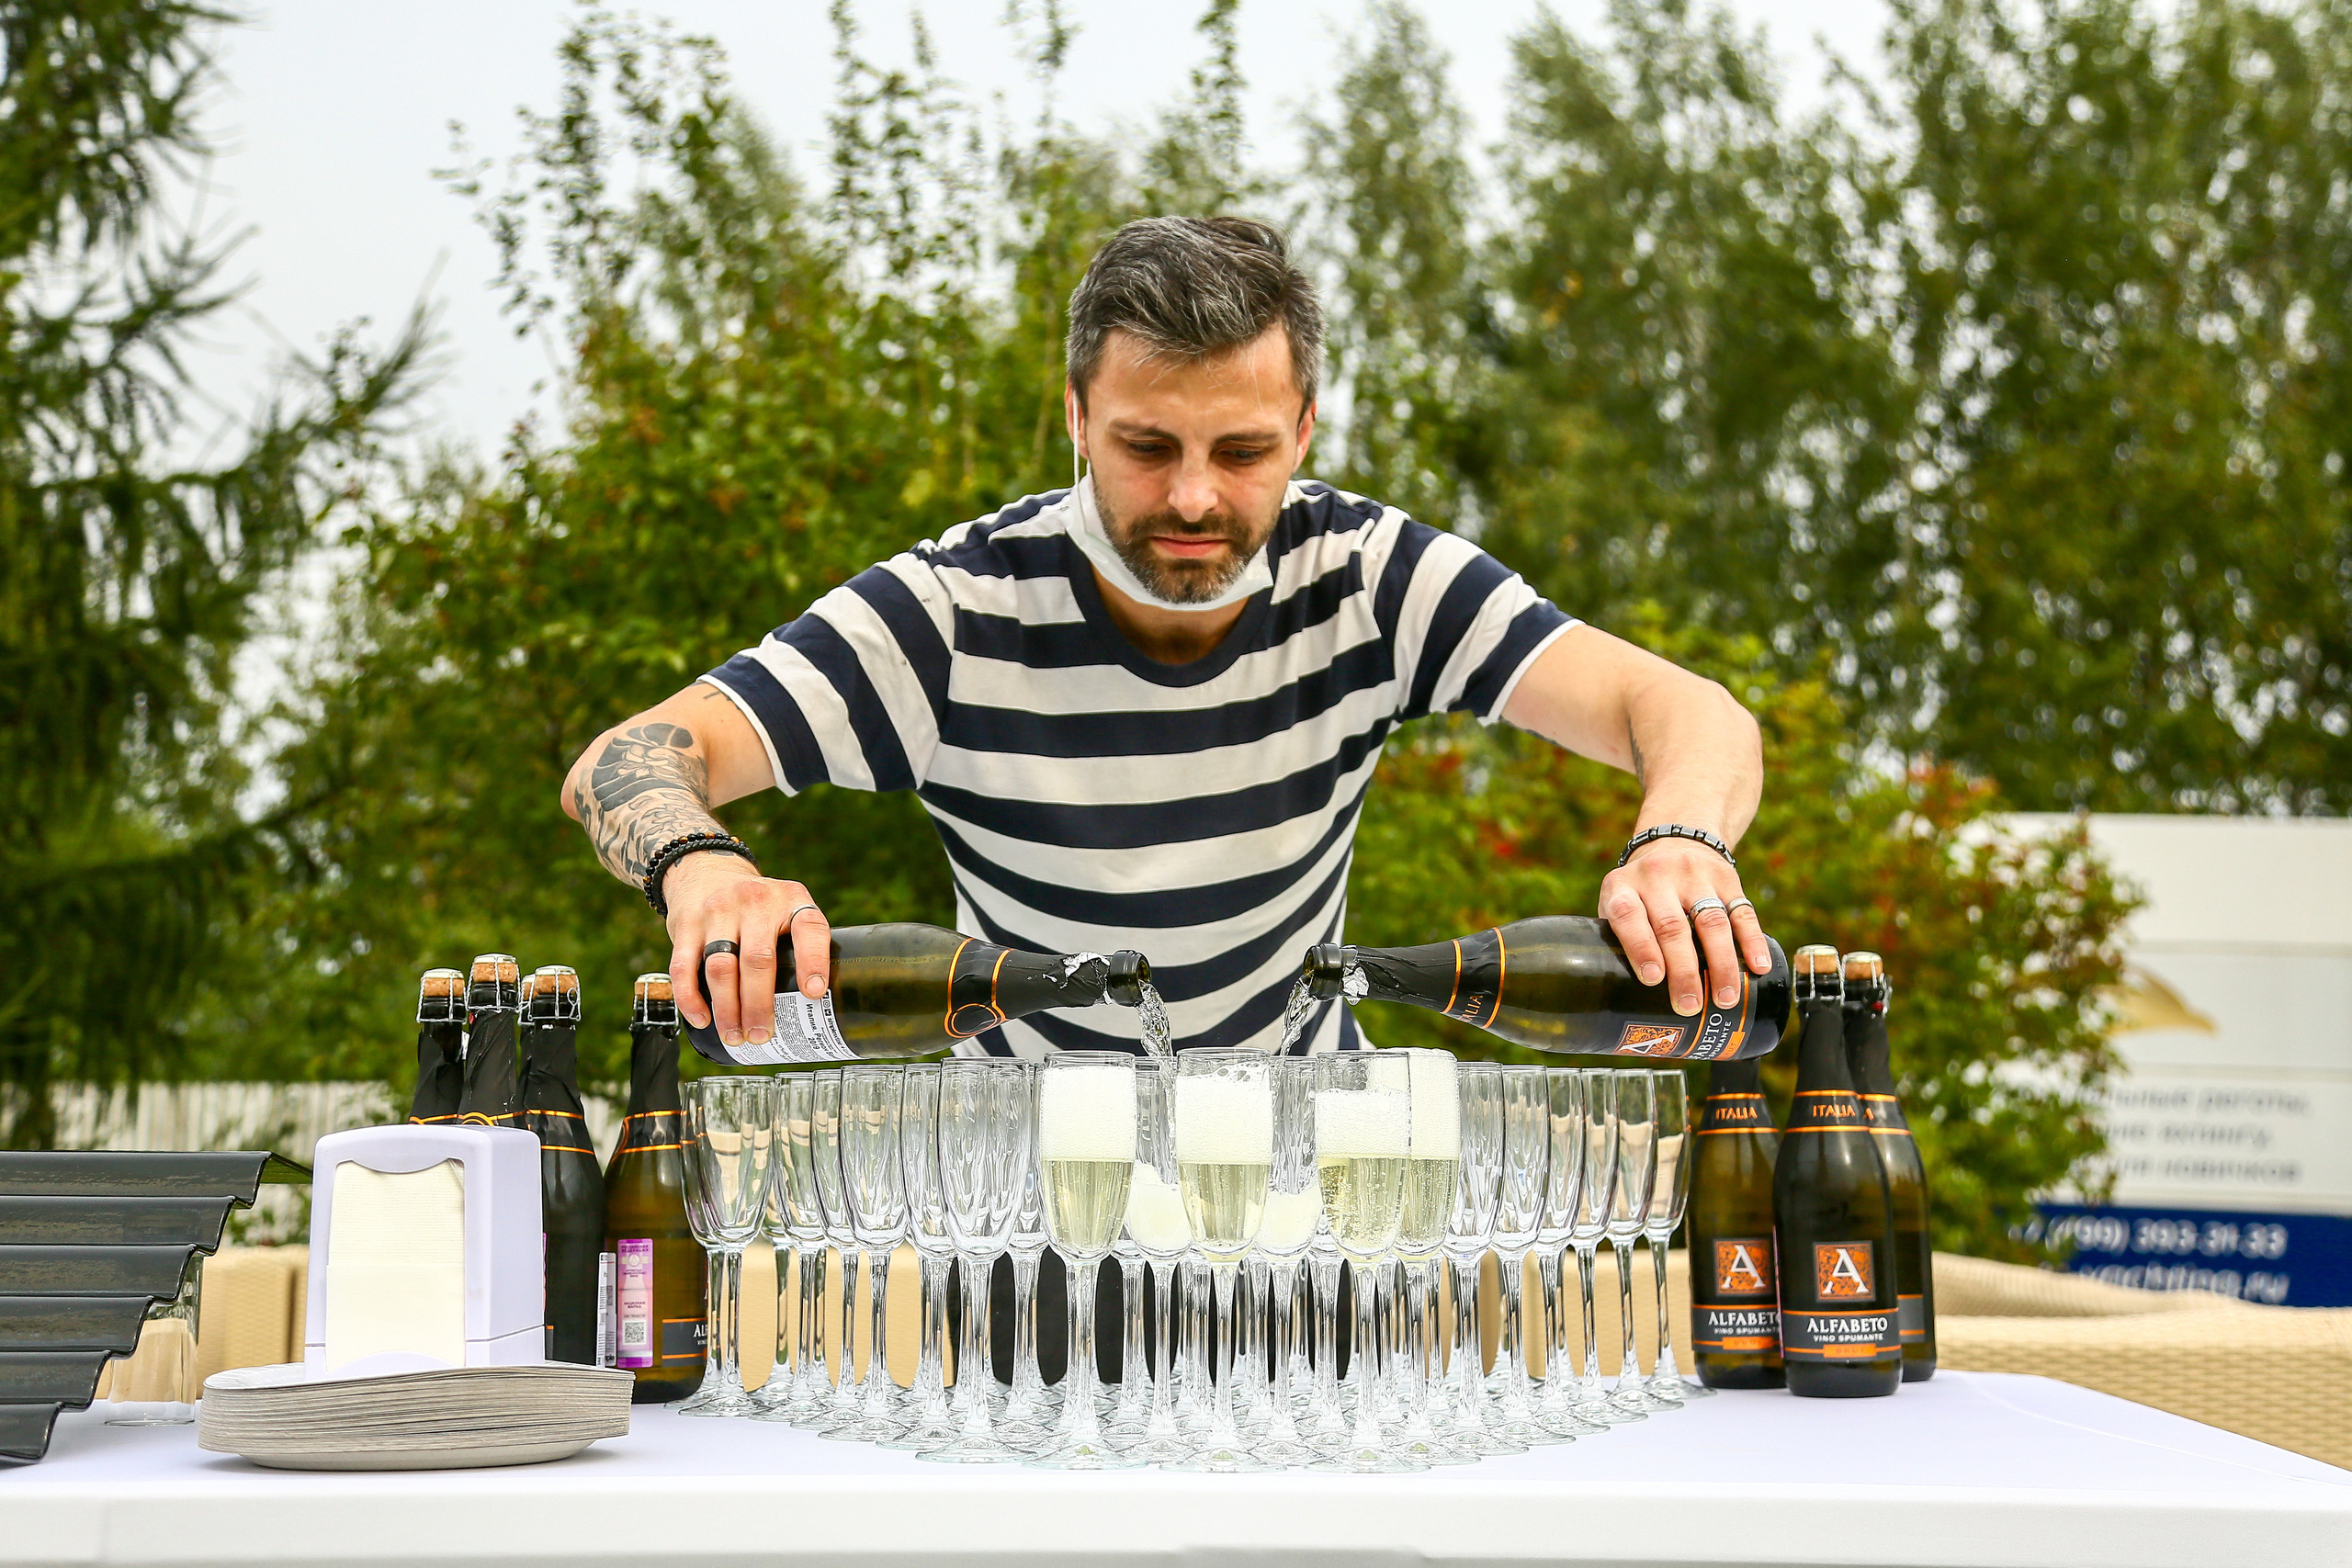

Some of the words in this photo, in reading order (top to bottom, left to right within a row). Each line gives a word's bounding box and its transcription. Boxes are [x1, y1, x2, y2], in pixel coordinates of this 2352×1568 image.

[808, 1036, 820, 1050] 2019
[1715, 1106, 1758, 1120] ITALIA
[1812, 1104, 1856, 1117] ITALIA
[1721, 1244, 1766, 1289] A
[1822, 1248, 1870, 1294] A
[1713, 1326, 1734, 1335] VINO
[1807, 1316, 1888, 1333] ALFABETO
[1813, 1334, 1836, 1343] VINO
[1838, 1333, 1884, 1342] SPUMANTE
